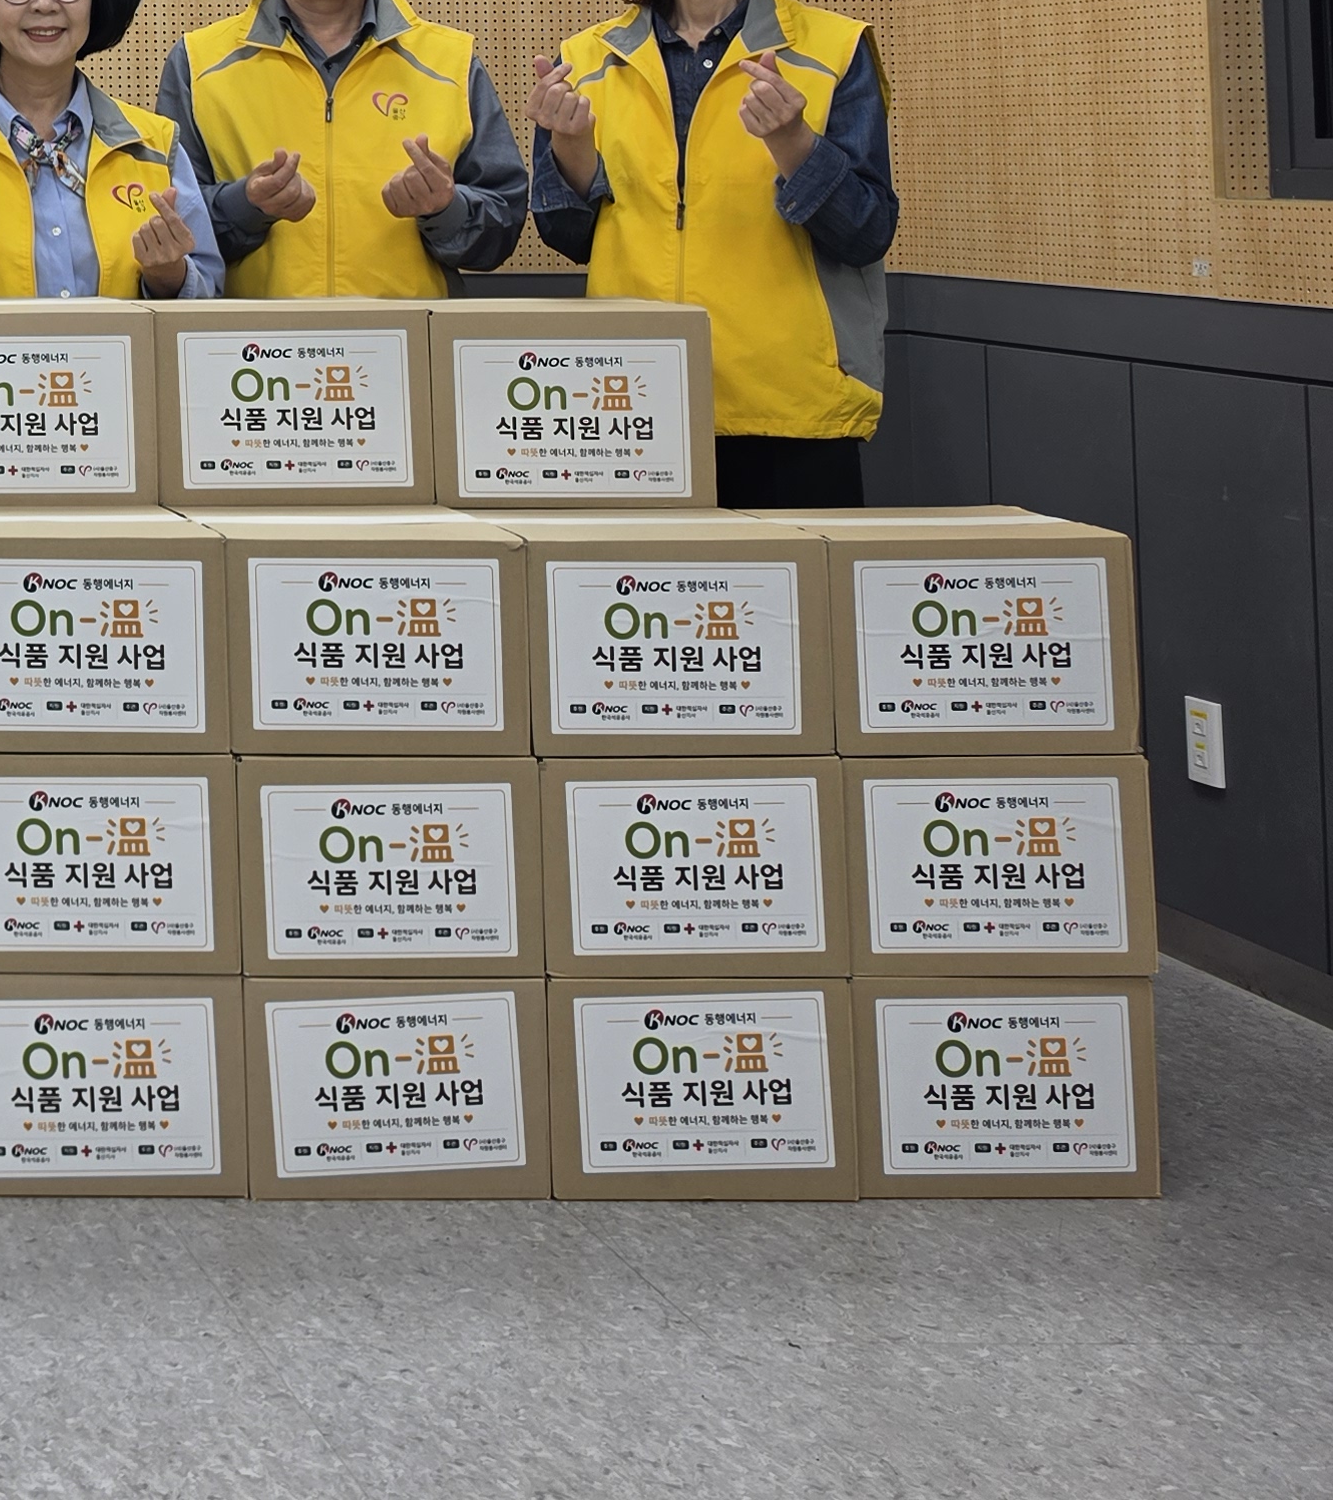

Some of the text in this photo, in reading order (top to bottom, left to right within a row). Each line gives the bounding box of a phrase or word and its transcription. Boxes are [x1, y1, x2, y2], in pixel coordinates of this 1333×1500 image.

[21, 352, 68, 363] 동행에너지
[518, 351, 623, 370] KNOC 동행에너지
[0, 412, 46, 436] 지원
[53, 412, 99, 436] 사업
[495, 416, 653, 440] 식품 지원 사업
[521, 448, 547, 457] 따뜻한
[579, 448, 612, 457] 함께하는
[614, 448, 631, 456] 행복
[923, 571, 1036, 593] KNOC 동행에너지
[899, 641, 1071, 670] 식품 지원 사업
[927, 678, 956, 688] 따뜻한
[991, 677, 1026, 687] 함께하는
[1029, 677, 1047, 686] 행복
[330, 797, 443, 819] KNOC 동행에너지
[306, 868, 477, 896] 식품 지원 사업
[334, 905, 362, 914] 따뜻한
[397, 904, 432, 914] 함께하는
[435, 904, 452, 913] 행복
[946, 1011, 1060, 1032] KNOC 동행에너지
[923, 1083, 1095, 1111] 식품 지원 사업
[951, 1119, 979, 1129] 따뜻한
[1014, 1119, 1050, 1129] 함께하는
[1052, 1118, 1070, 1128] 행복
